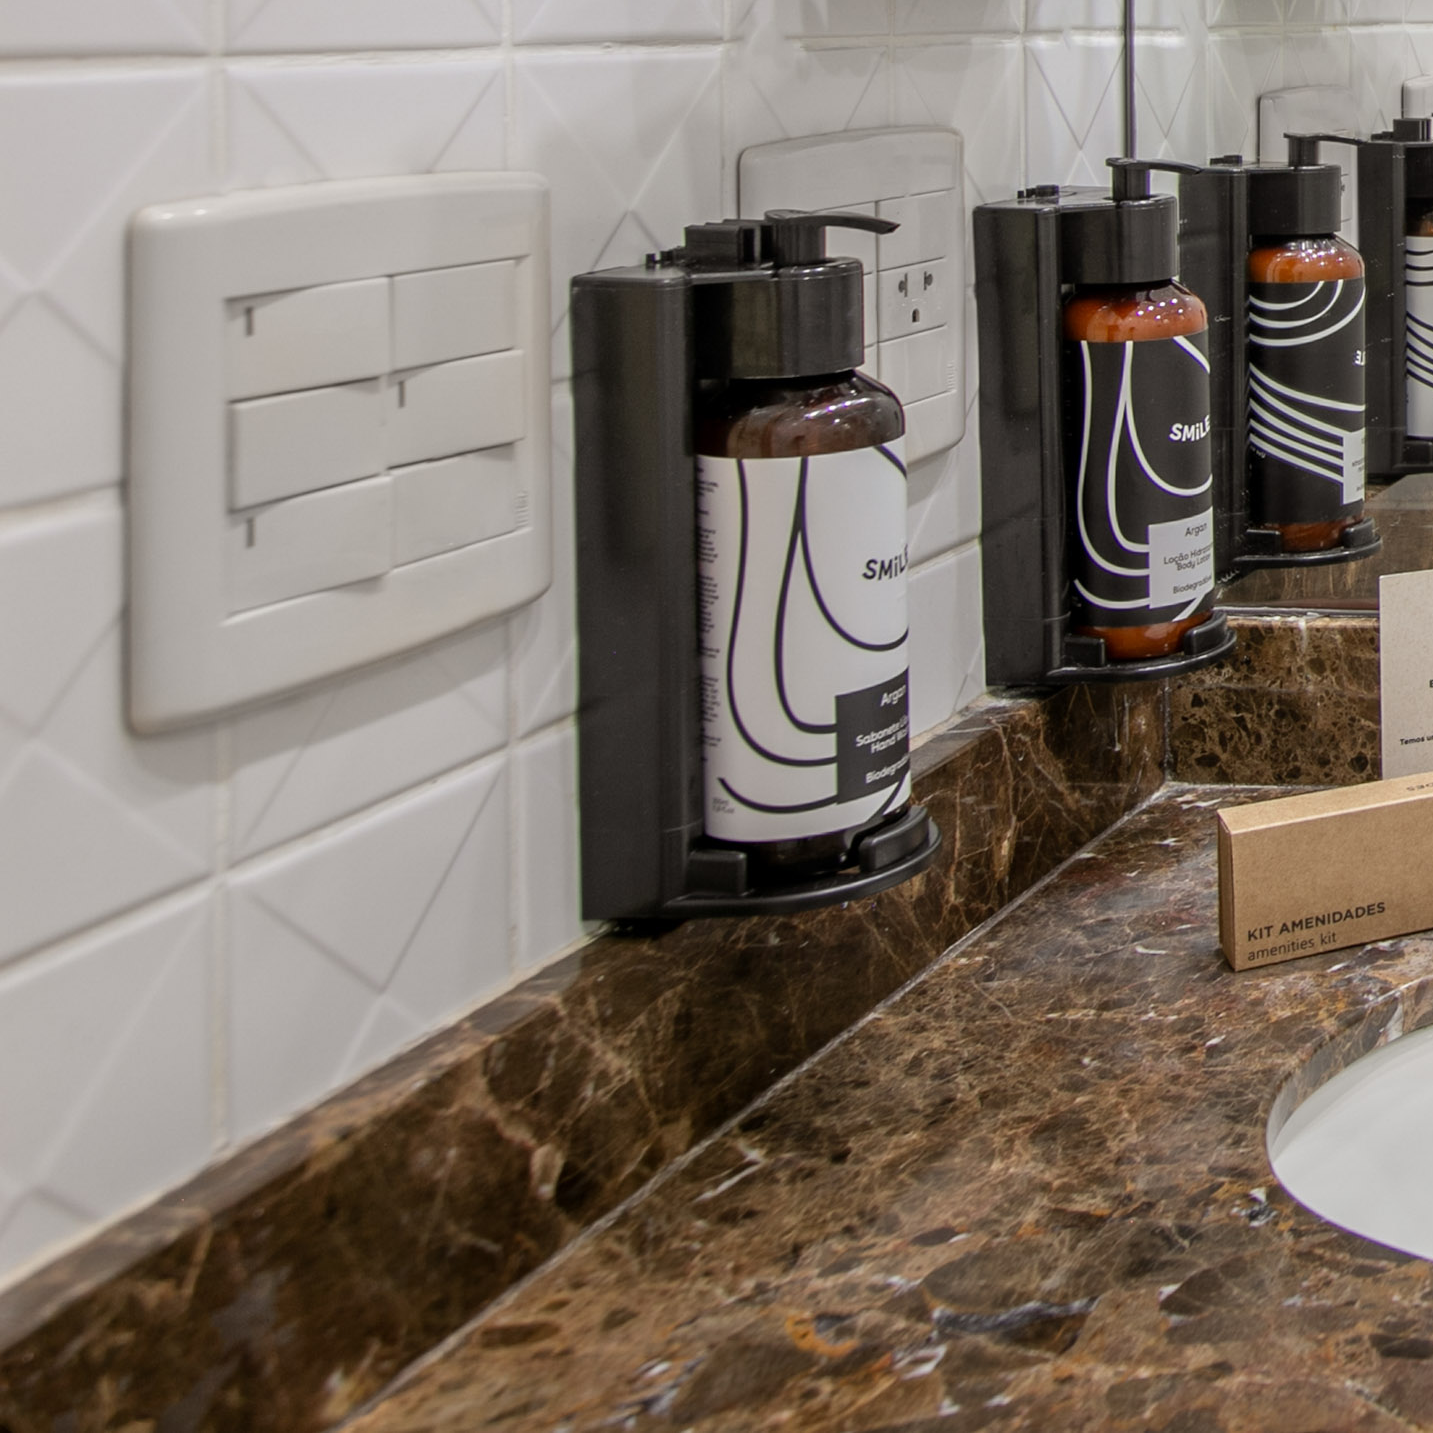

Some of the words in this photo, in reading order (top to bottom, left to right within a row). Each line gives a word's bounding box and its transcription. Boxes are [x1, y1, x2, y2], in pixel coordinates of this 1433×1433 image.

[1177, 559, 1196, 571] Body
[856, 722, 899, 747] Sabonete
[871, 734, 896, 754] Hand
[1400, 737, 1425, 746] Temos
[1247, 925, 1274, 942] KIT
[1279, 902, 1386, 935] AMENIDADES
[1247, 937, 1315, 961] amenities
[1320, 932, 1337, 946] kit
